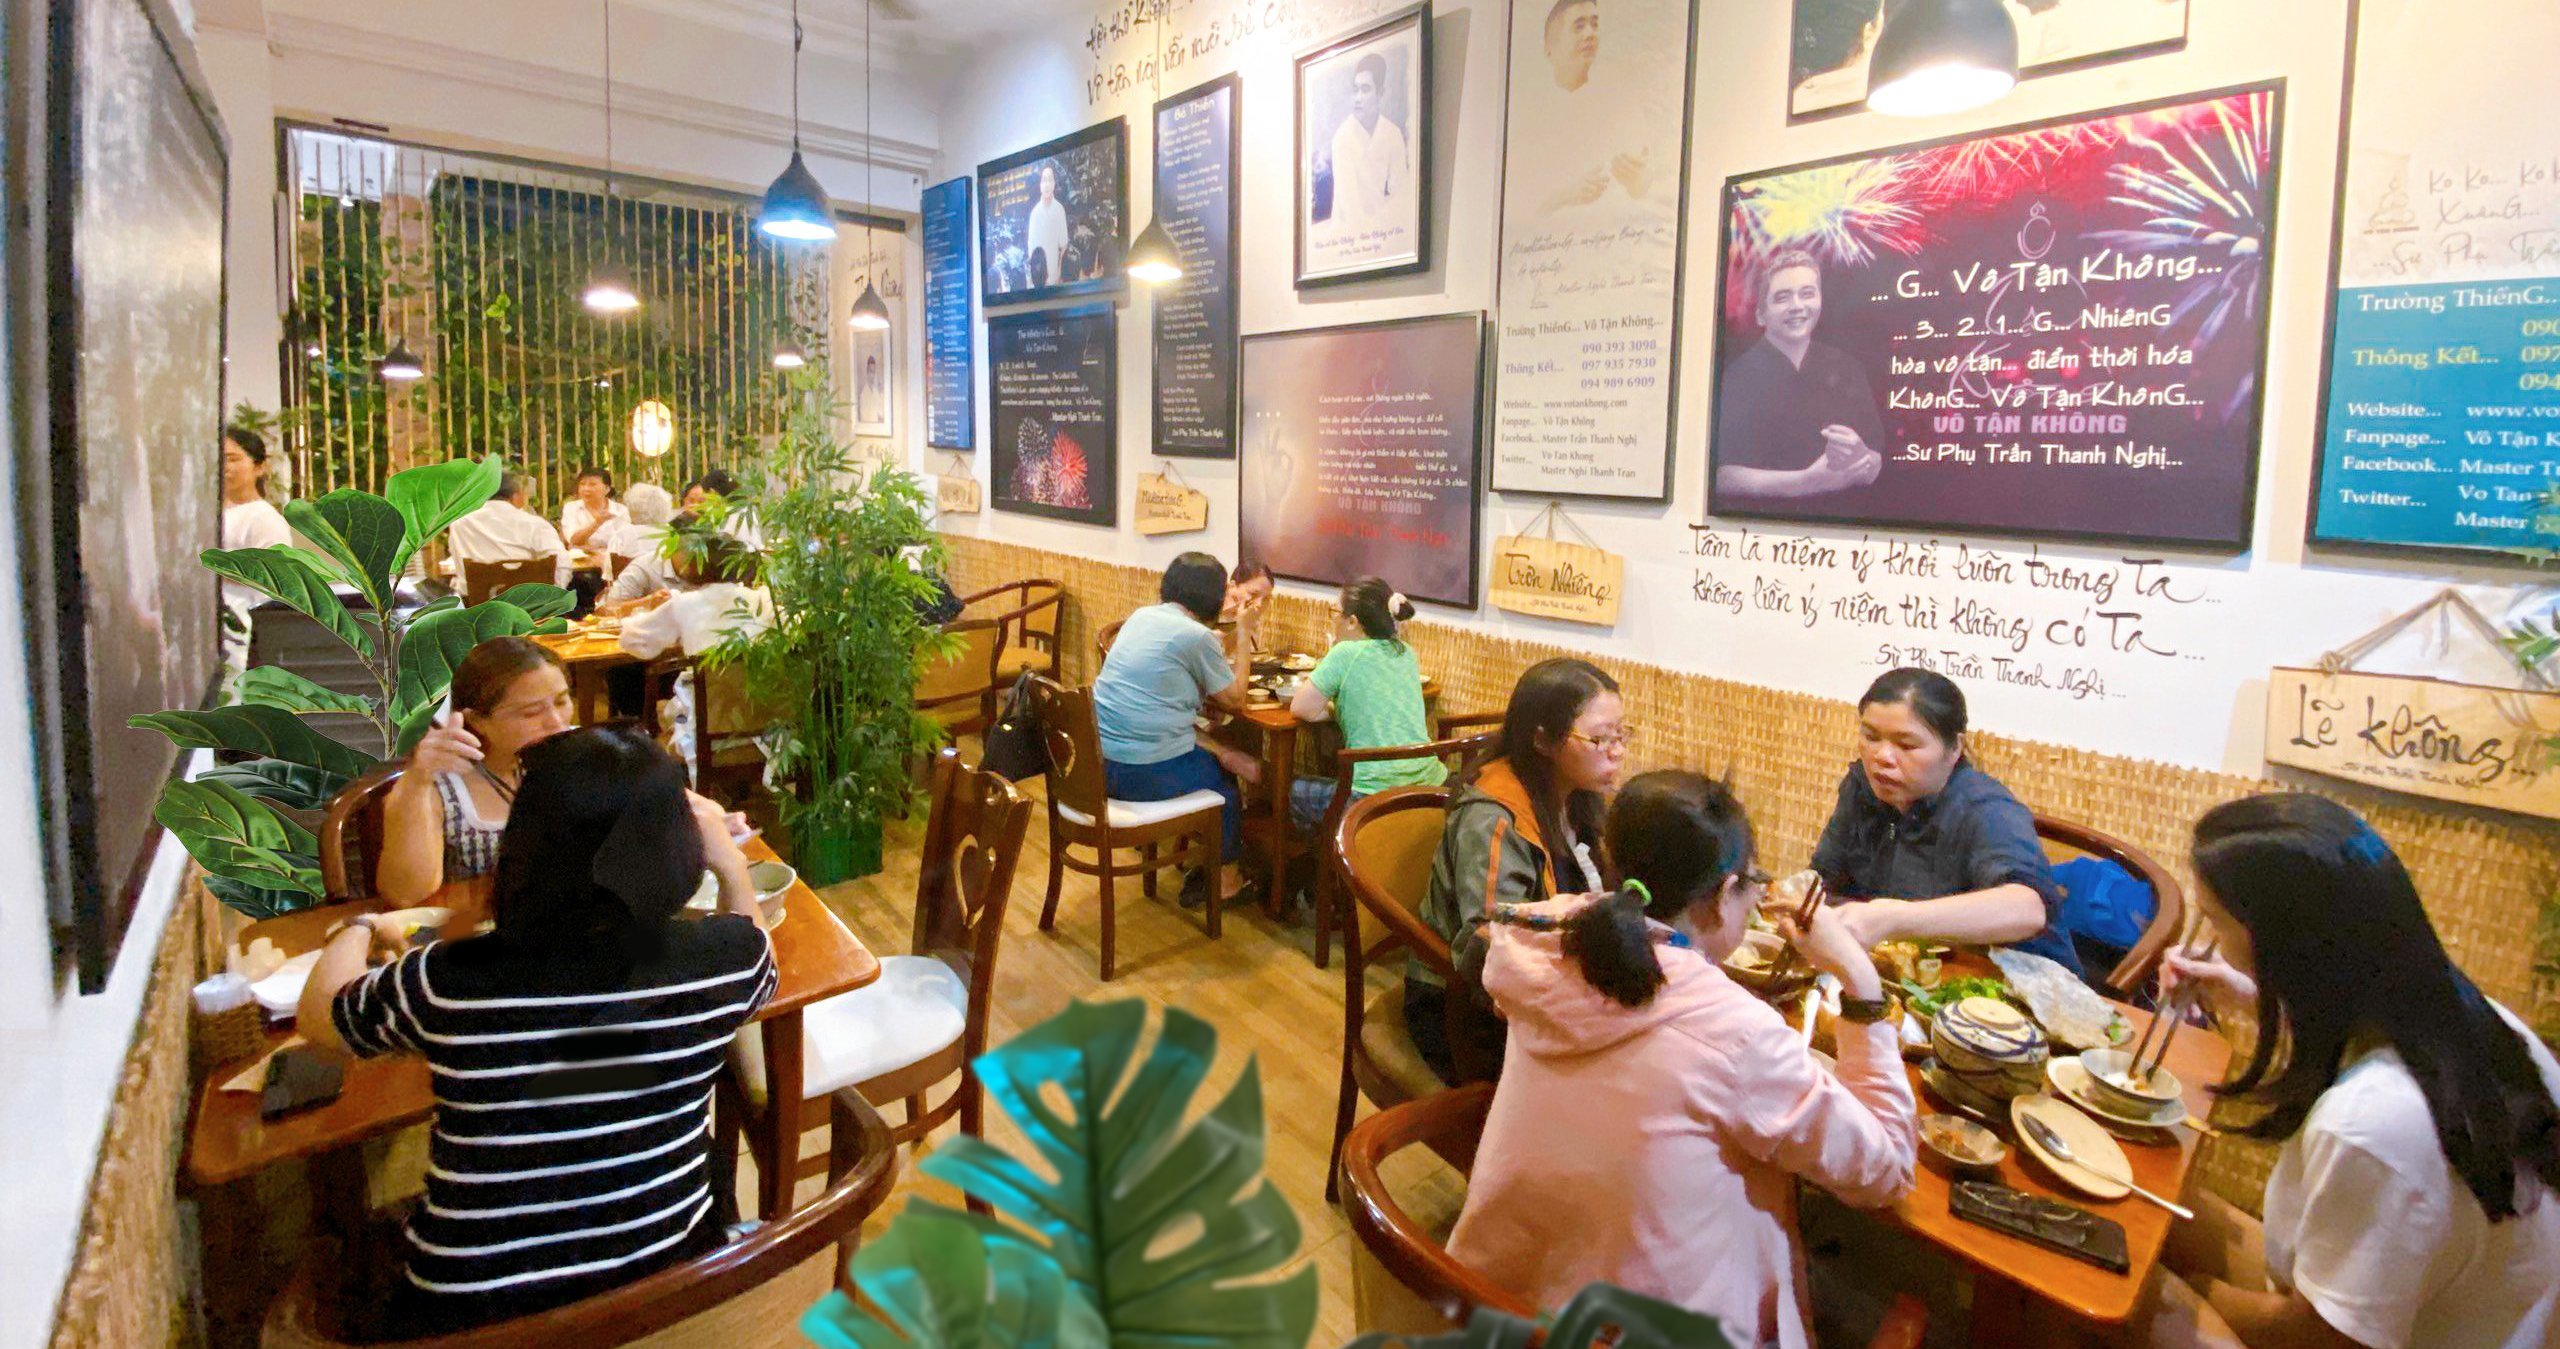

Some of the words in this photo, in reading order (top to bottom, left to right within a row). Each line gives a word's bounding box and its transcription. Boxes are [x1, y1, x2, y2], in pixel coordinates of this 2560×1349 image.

[1953, 261, 1998, 294] Vô
[2009, 261, 2068, 293] Tận
[2082, 249, 2223, 283] Không...
[2081, 302, 2171, 330] NhiênG
[2357, 291, 2446, 314] Trường
[1891, 355, 1926, 375] hòa
[1934, 356, 1958, 373] vô
[2027, 346, 2079, 370] điểm
[2089, 346, 2138, 368] thời
[2147, 343, 2193, 366] hóa
[2351, 347, 2429, 370] Thông
[1990, 383, 2027, 408] Vô
[2036, 386, 2082, 411] Tận
[1933, 413, 1965, 433] VÔ
[1974, 412, 2021, 438] TẬN
[2031, 411, 2128, 434] KHÔNG
[2464, 429, 2492, 446] Vô
[2497, 429, 2539, 449] Tận
[1937, 443, 1976, 466] Phụ
[1983, 442, 2032, 464] Trần
[2040, 443, 2106, 465] Thanh
[2459, 458, 2534, 475] Master
[2458, 485, 2488, 501] Vo
[2493, 486, 2532, 502] Tan
[2455, 511, 2529, 530] Master
[1773, 535, 1838, 572] niệm
[1953, 543, 2016, 584] luôn
[2024, 543, 2119, 605] trong
[1831, 591, 1895, 628] niệm
[1899, 593, 1944, 630] thì
[1950, 596, 2034, 653] không
[2045, 606, 2091, 648] có
[1940, 650, 1986, 680] Trần
[1992, 657, 2051, 689] Thanh
